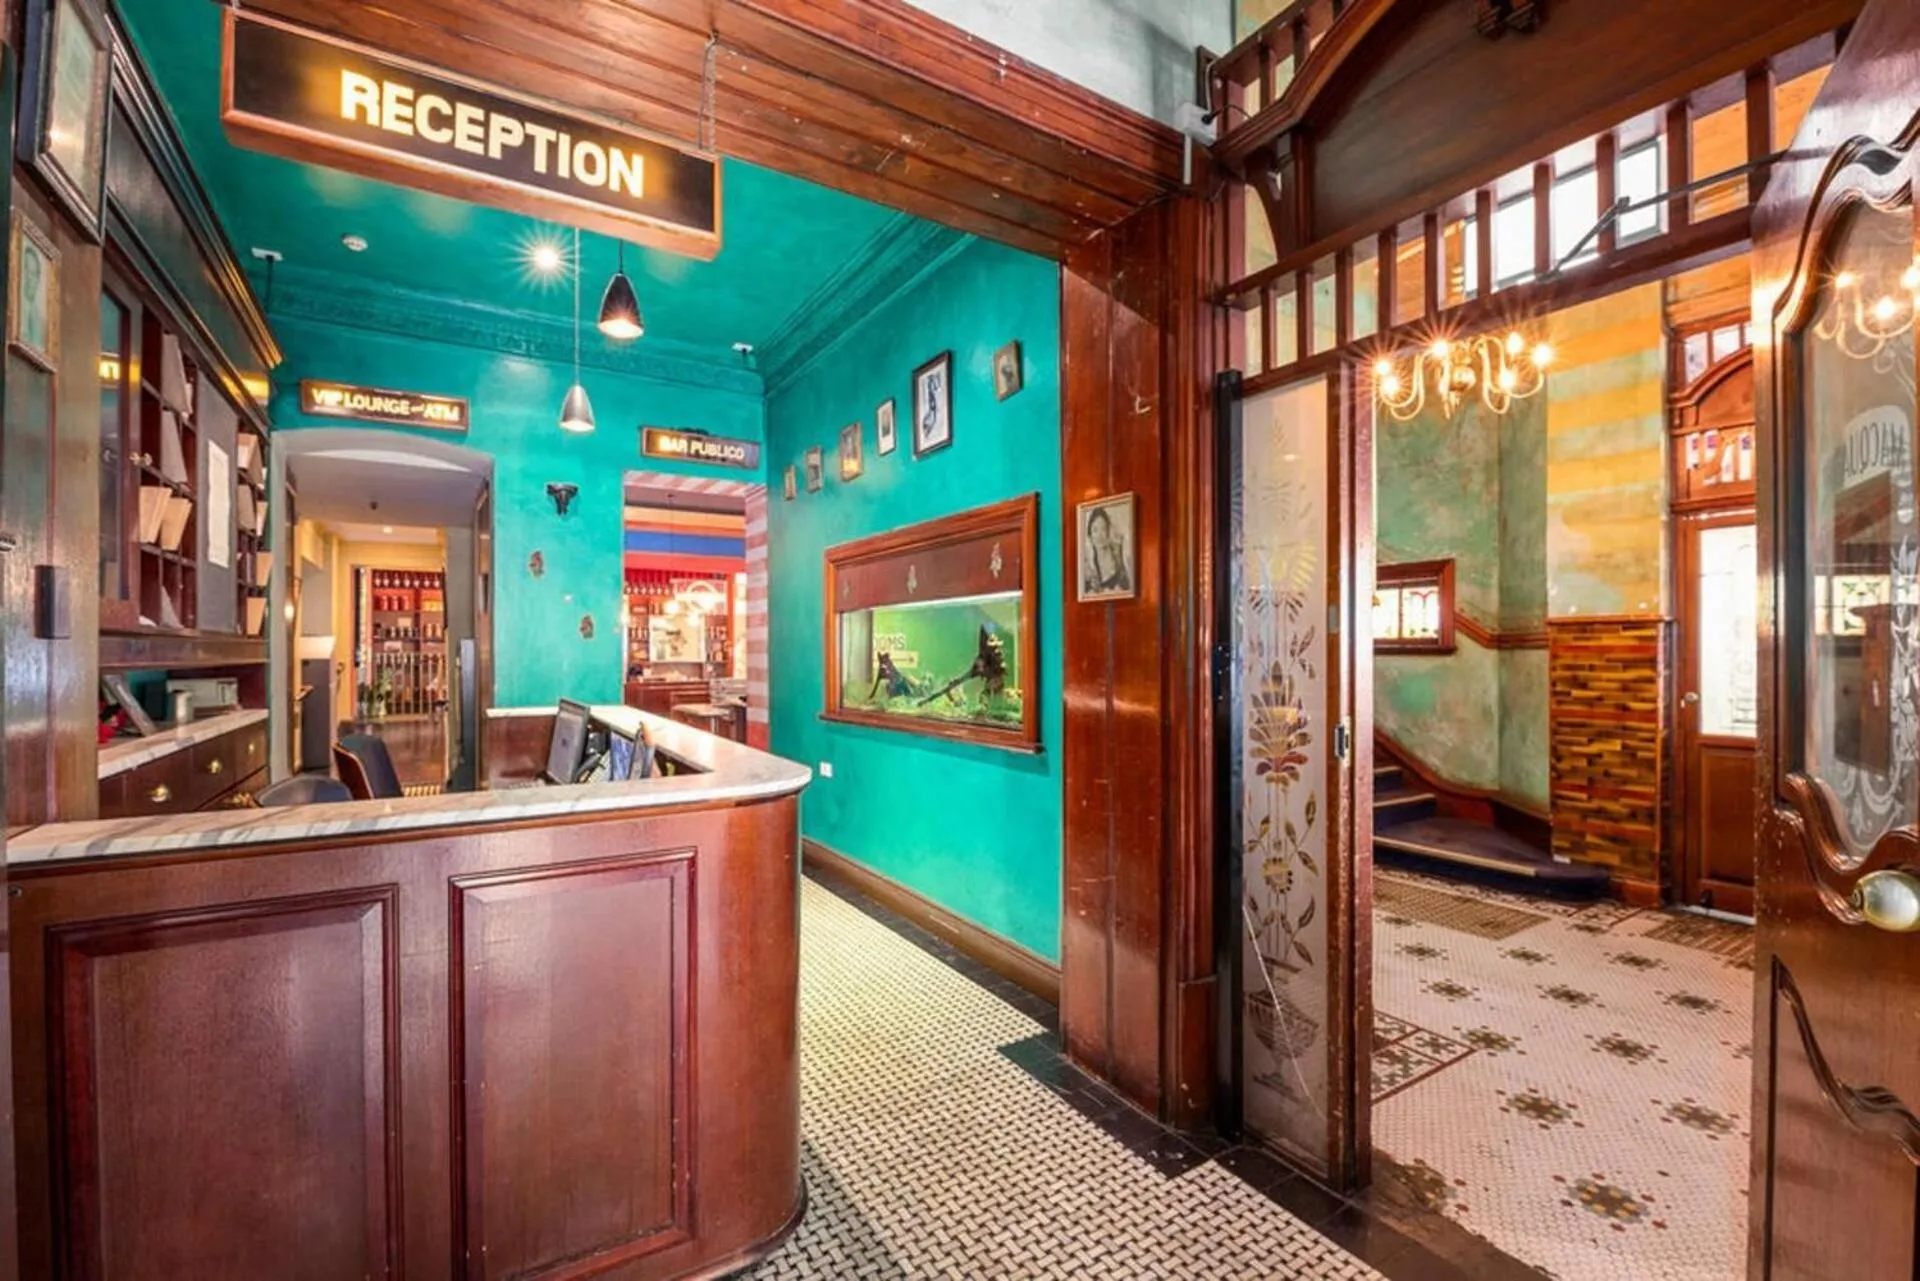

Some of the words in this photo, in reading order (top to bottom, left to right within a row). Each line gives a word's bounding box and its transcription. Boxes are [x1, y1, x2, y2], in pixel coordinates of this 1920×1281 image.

[340, 69, 644, 199] RECEPTION
[312, 388, 342, 407] VIP
[343, 392, 410, 415] LOUNGE
[424, 403, 460, 422] ATM
[690, 440, 745, 460] PUBLICO
